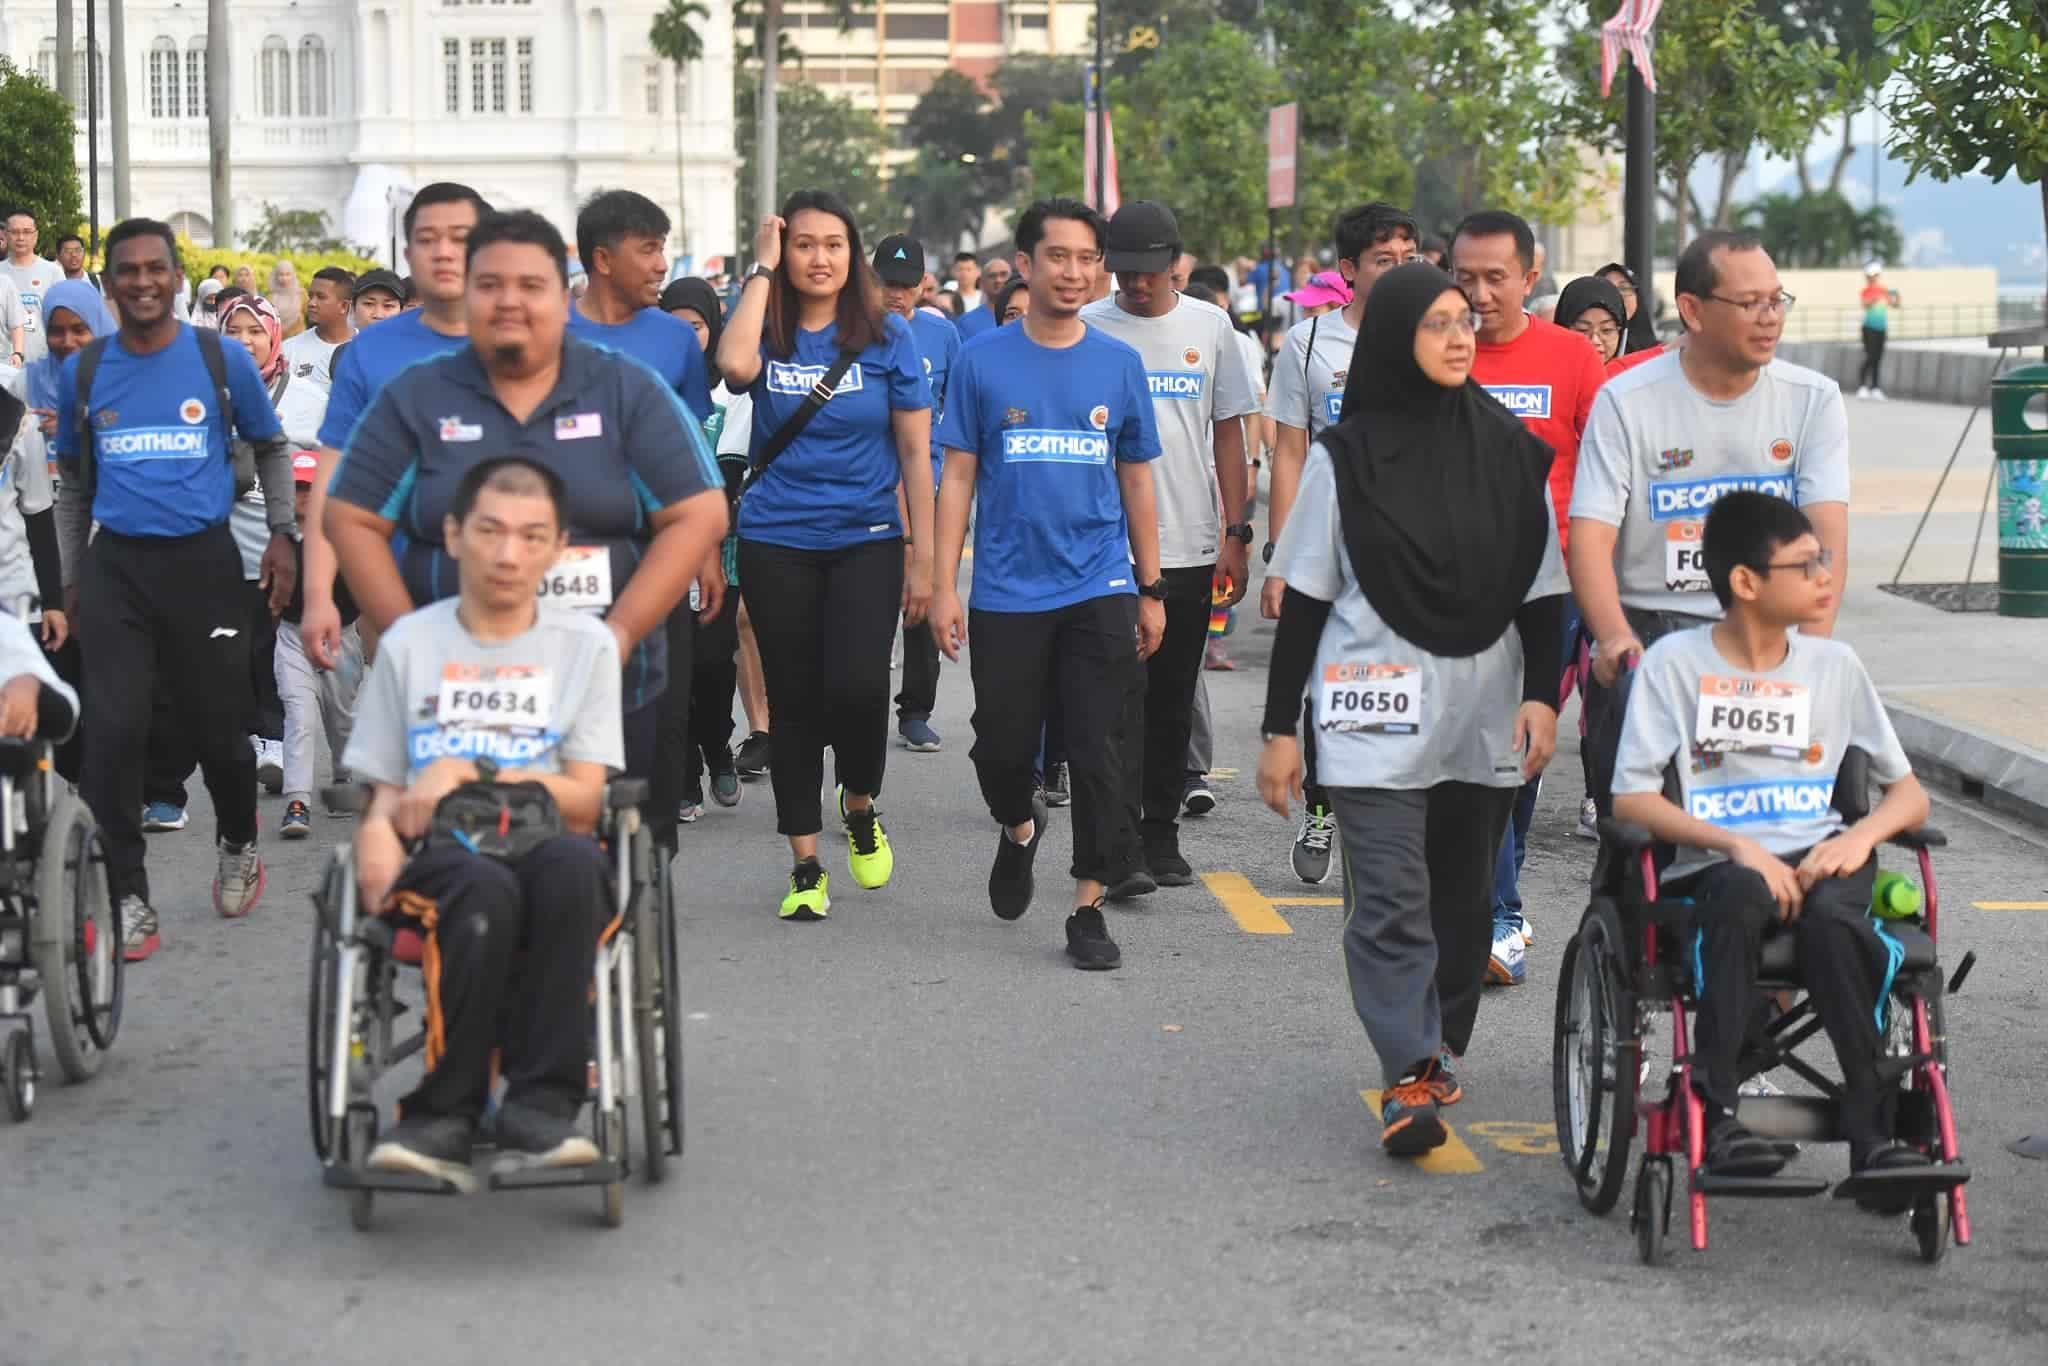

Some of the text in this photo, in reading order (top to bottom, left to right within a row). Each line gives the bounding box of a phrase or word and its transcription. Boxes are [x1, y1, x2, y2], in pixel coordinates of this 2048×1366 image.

[101, 432, 203, 455] DECATHLON
[1006, 435, 1107, 457] DECATHLON
[453, 690, 537, 715] F0634
[1331, 691, 1409, 714] F0650
[1711, 705, 1796, 737] F0651
[1691, 782, 1834, 821] DECATHLON
